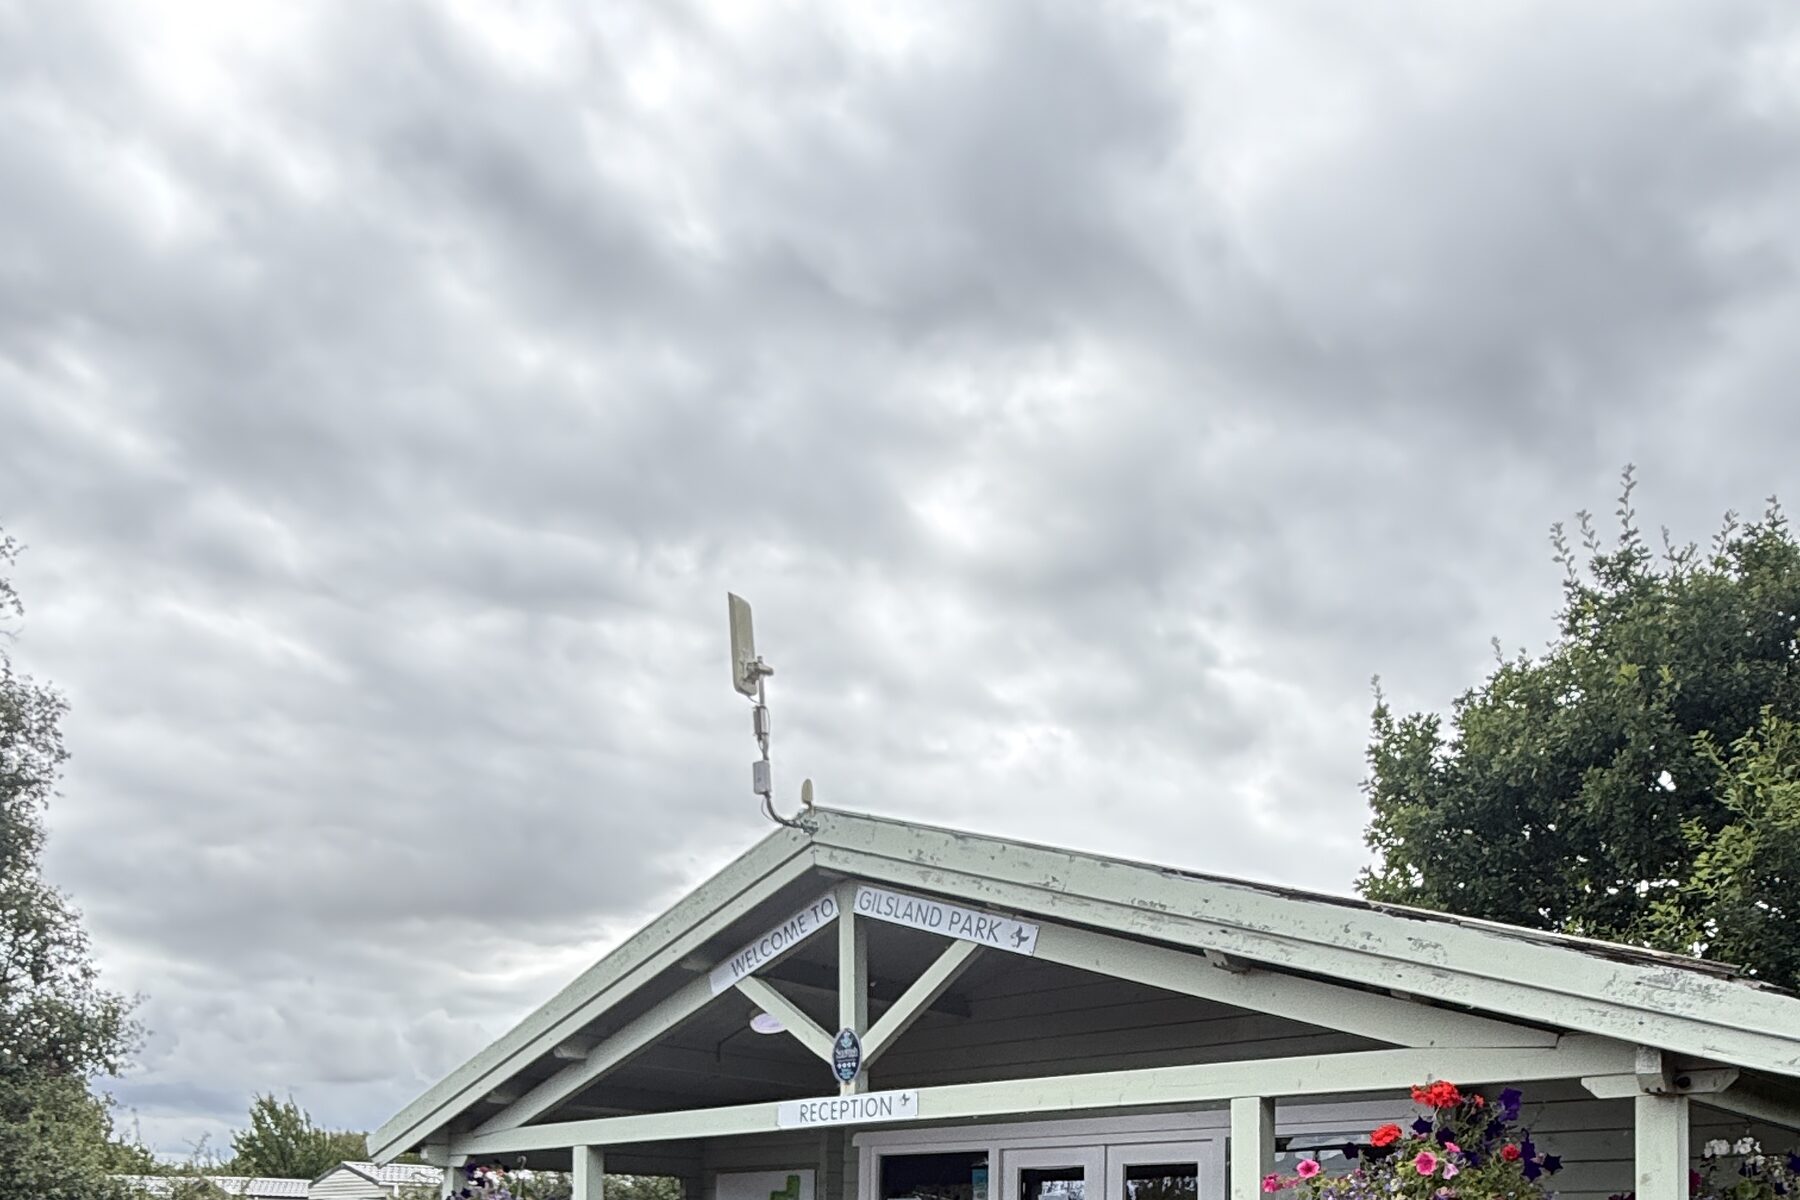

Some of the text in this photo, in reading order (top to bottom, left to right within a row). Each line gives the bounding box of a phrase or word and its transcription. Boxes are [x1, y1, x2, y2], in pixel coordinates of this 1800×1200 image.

[731, 898, 834, 977] WELCOME TO
[858, 890, 1003, 943] GILSLAND PARK
[800, 1096, 892, 1122] RECEPTION
